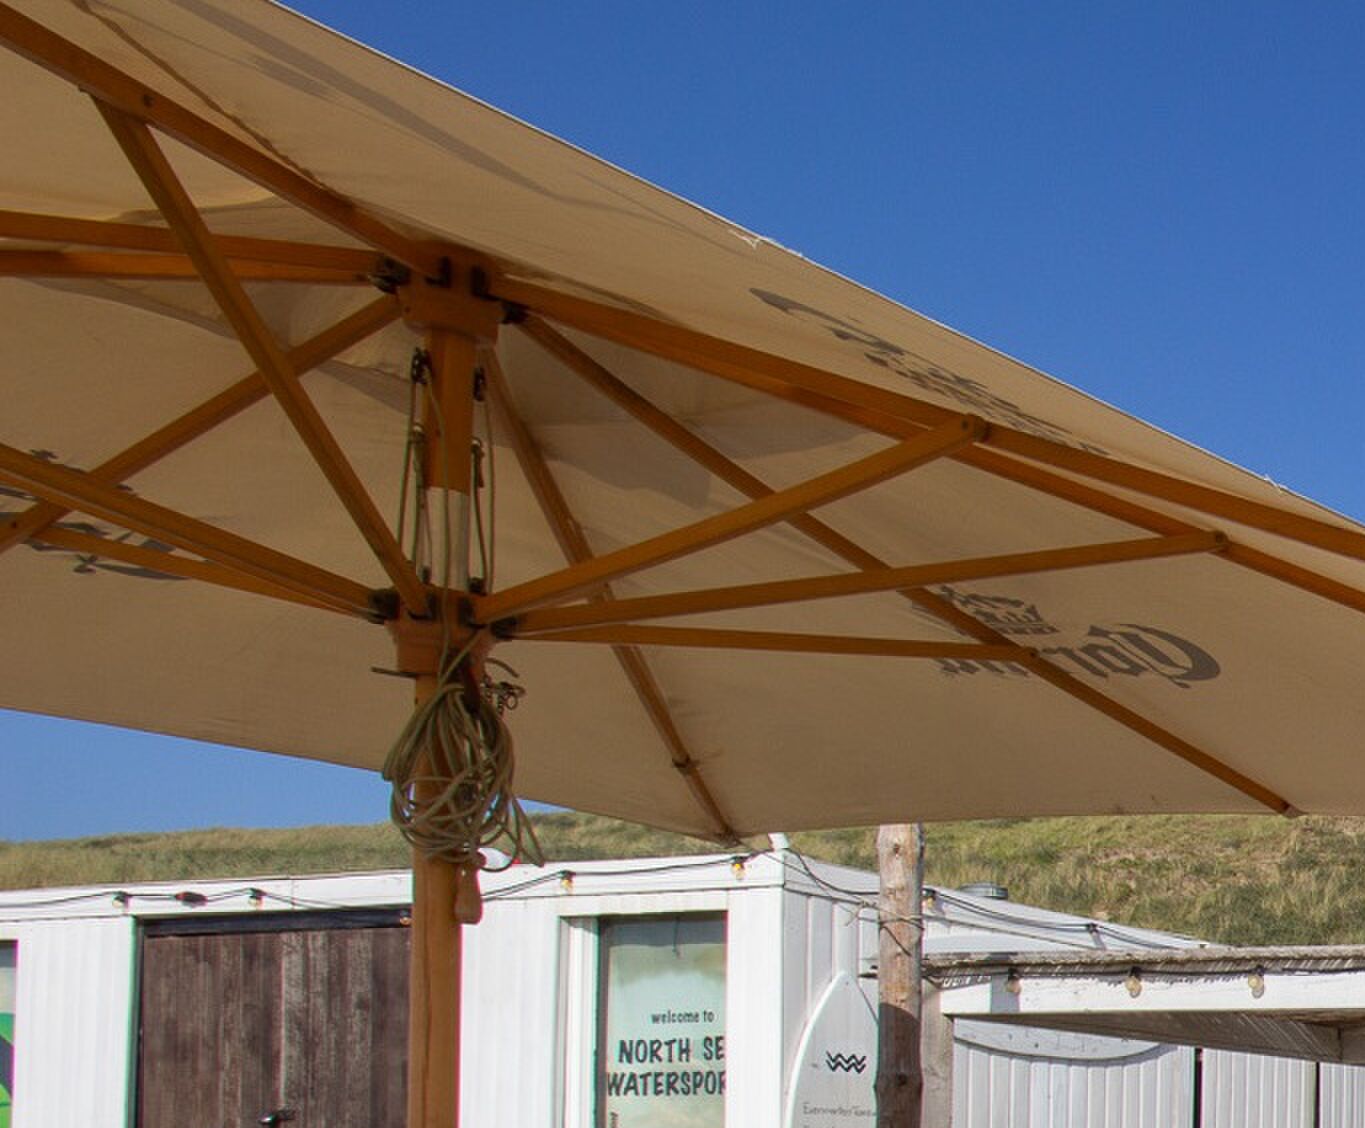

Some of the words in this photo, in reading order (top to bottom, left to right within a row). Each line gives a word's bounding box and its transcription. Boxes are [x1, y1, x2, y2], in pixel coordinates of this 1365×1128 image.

[650, 1009, 699, 1024] welcome
[703, 1009, 715, 1023] to
[618, 1037, 690, 1064] NORTH
